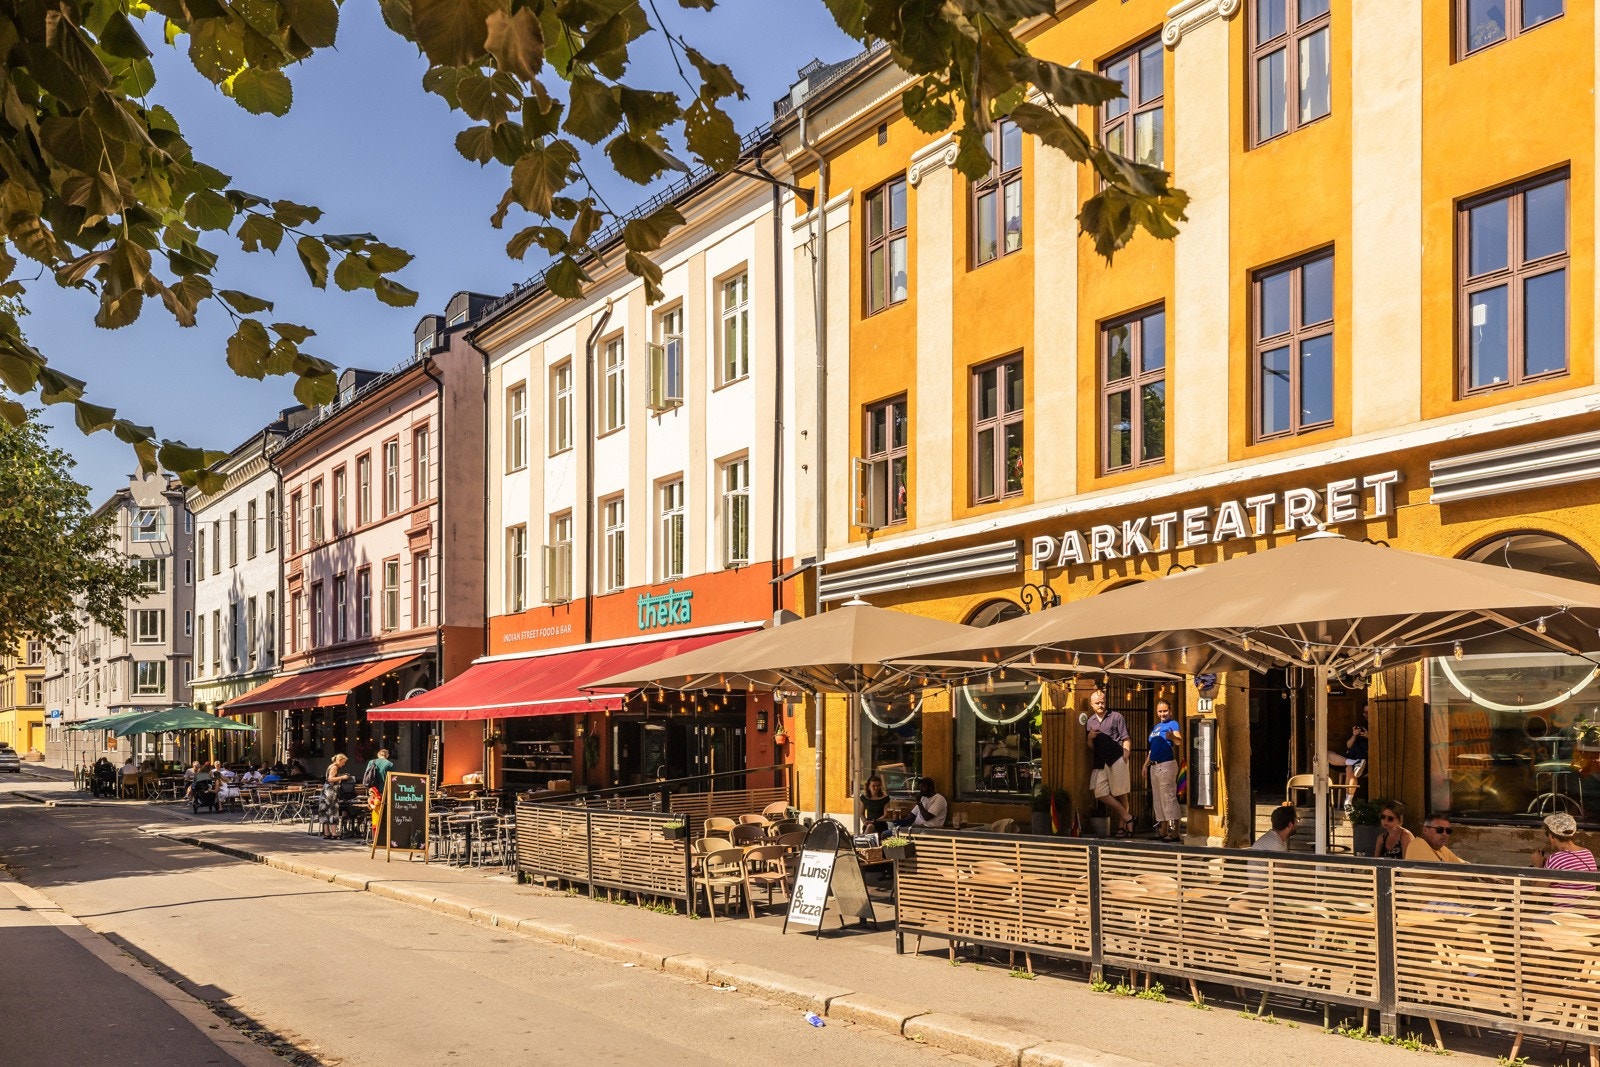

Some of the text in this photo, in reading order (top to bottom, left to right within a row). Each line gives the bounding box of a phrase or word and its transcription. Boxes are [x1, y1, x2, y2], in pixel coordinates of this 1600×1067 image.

[1032, 470, 1403, 570] PARKTEATRET
[637, 588, 693, 630] theka
[503, 632, 521, 643] INDIAN
[520, 629, 539, 640] STREET
[539, 627, 555, 638] FOOD
[560, 624, 572, 634] BAR
[1200, 700, 1209, 711] 11
[394, 793, 411, 801] Lunch
[800, 863, 831, 883] Lunsj
[795, 885, 803, 899] &
[792, 899, 822, 917] Pizza
